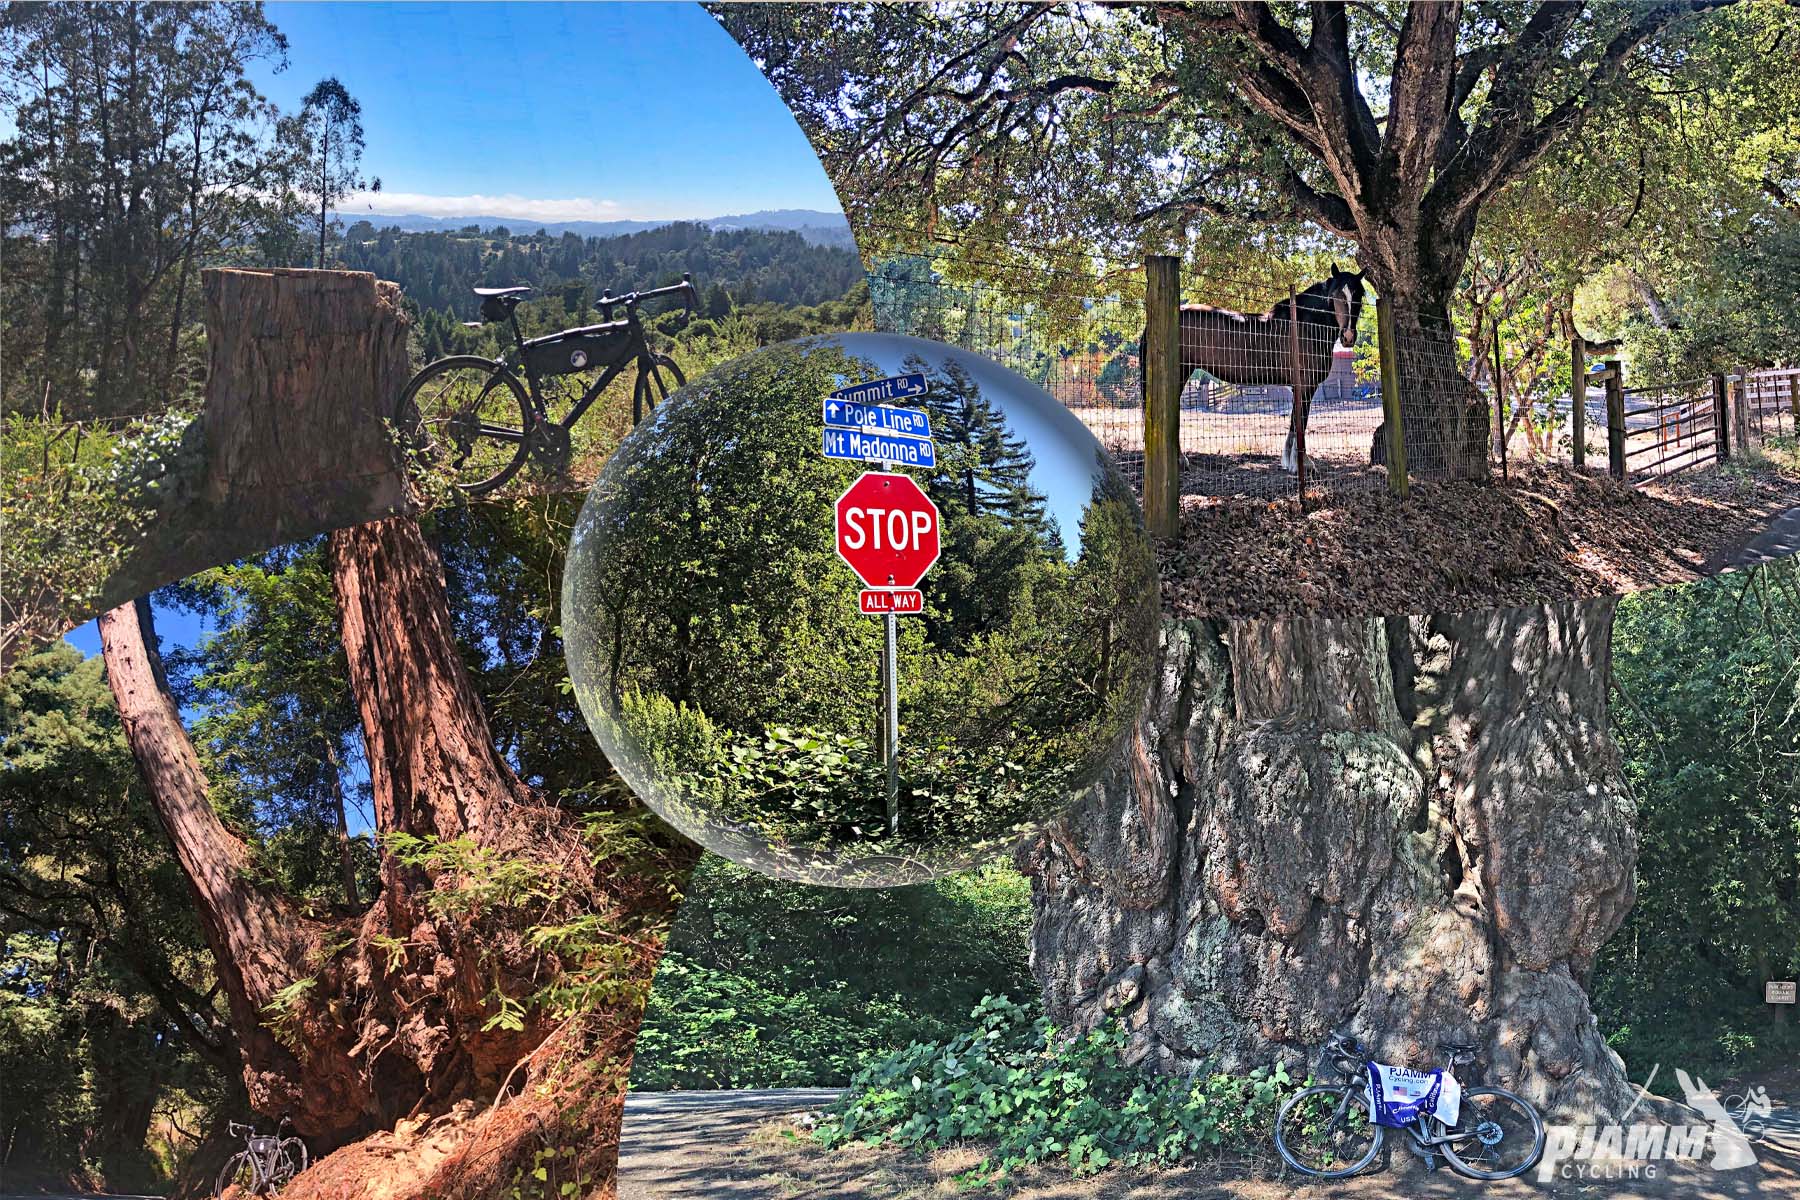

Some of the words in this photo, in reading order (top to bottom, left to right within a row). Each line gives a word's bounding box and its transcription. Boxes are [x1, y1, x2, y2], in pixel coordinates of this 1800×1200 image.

[896, 378, 909, 390] RD
[845, 404, 877, 426] Pole
[882, 408, 913, 431] Line
[912, 414, 925, 428] RD
[825, 431, 845, 455] Mt
[850, 433, 918, 462] Madonna
[919, 442, 932, 458] RD
[844, 506, 932, 551] STOP
[866, 595, 889, 609] ALL
[892, 594, 917, 609] WAY
[1389, 1067, 1431, 1079] PJAMM
[1400, 1115, 1417, 1123] USA
